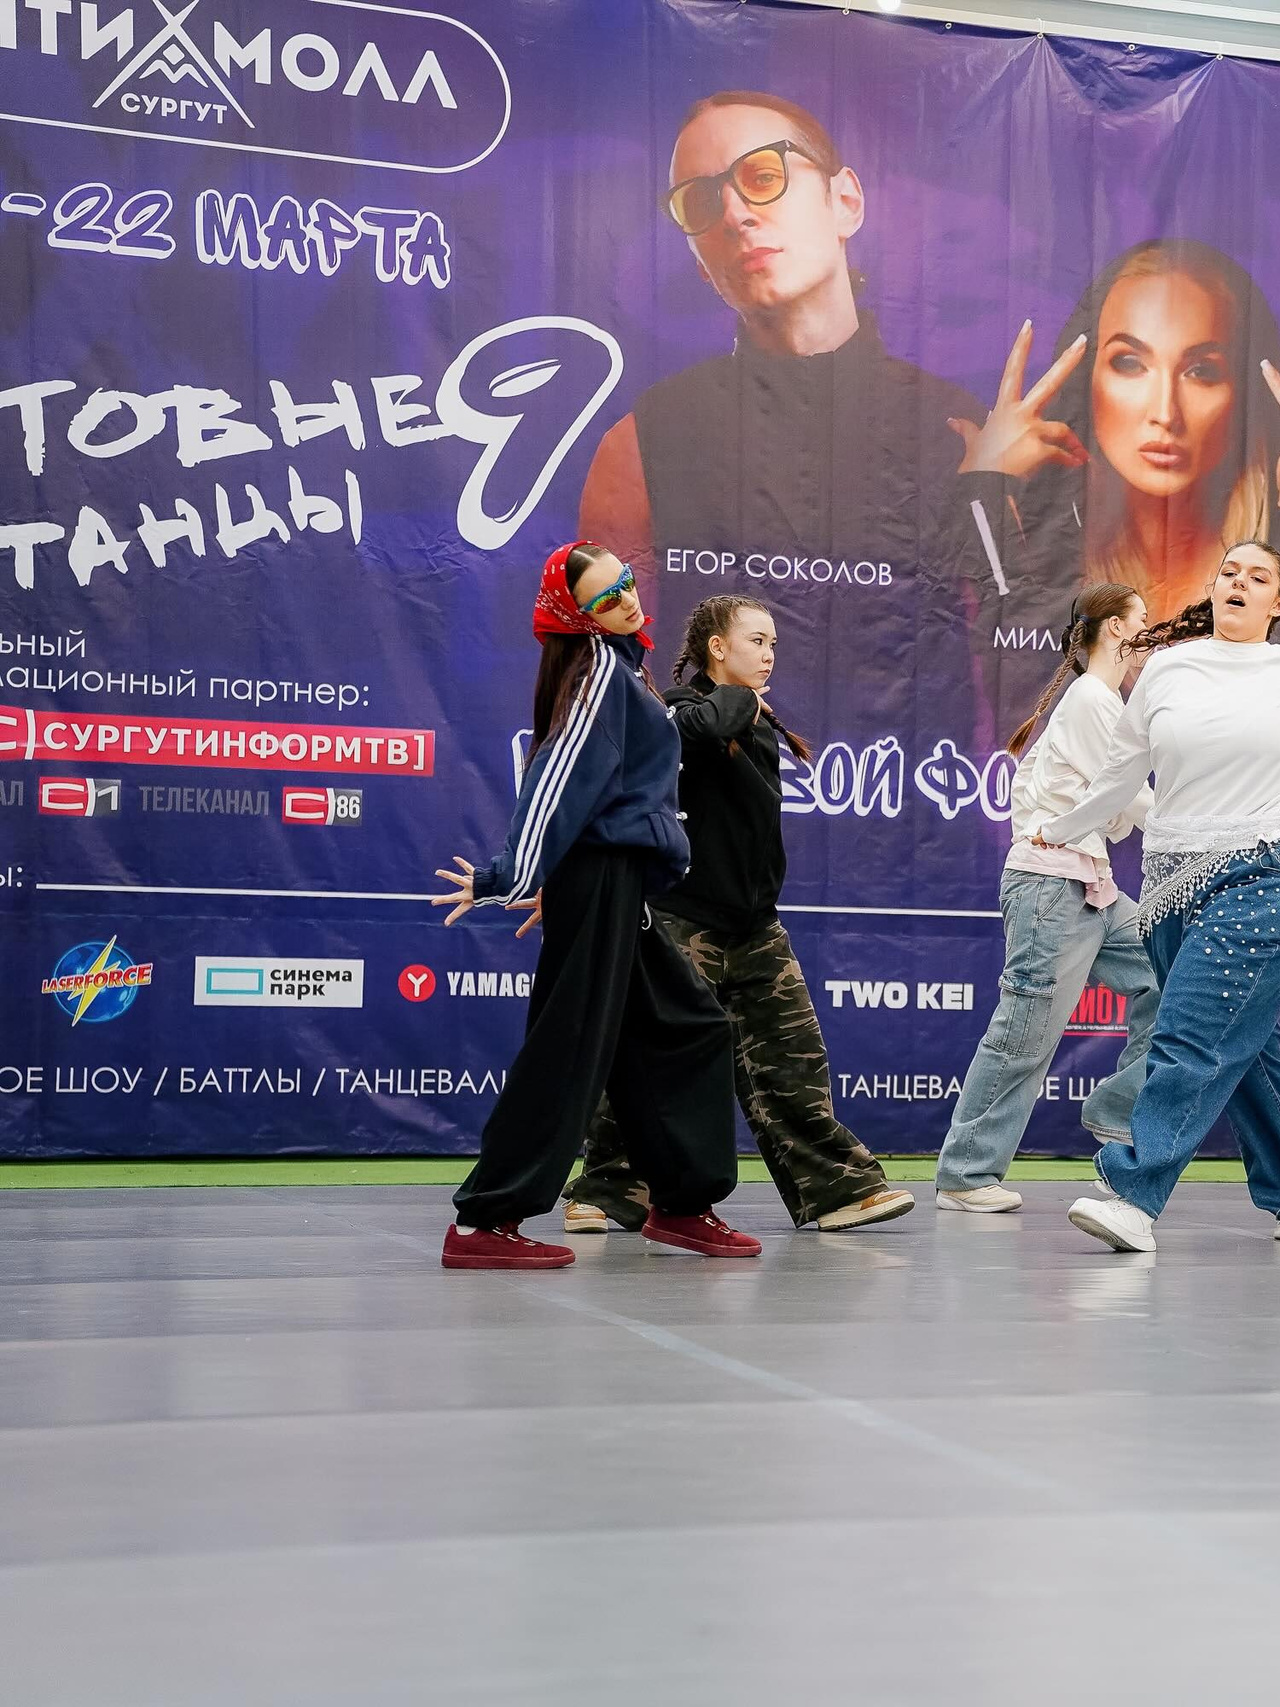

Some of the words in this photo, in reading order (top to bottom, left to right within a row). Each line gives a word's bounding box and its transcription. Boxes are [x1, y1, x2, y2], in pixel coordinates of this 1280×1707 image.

[213, 21, 457, 110] МОЛЛ
[120, 93, 228, 124] СУРГУТ
[196, 189, 450, 289] МАРТА
[0, 466, 362, 591] ТАНЦЫ
[666, 548, 736, 575] ЕГОР
[745, 554, 893, 586] СОКОЛОВ
[993, 626, 1063, 652] МИЛ
[0, 666, 196, 698] ационный
[209, 677, 369, 711] партнер:
[138, 786, 270, 816] ТЕЛЕКАНАЛ
[41, 963, 153, 994] LASERFORCE
[269, 968, 353, 983] синема
[269, 982, 325, 1000] парк
[447, 971, 536, 998] YAMAG
[824, 980, 908, 1010] TWO
[917, 983, 975, 1011] KEI
[55, 1067, 143, 1094] ШОУ
[179, 1067, 301, 1094] БАТТЛЫ
